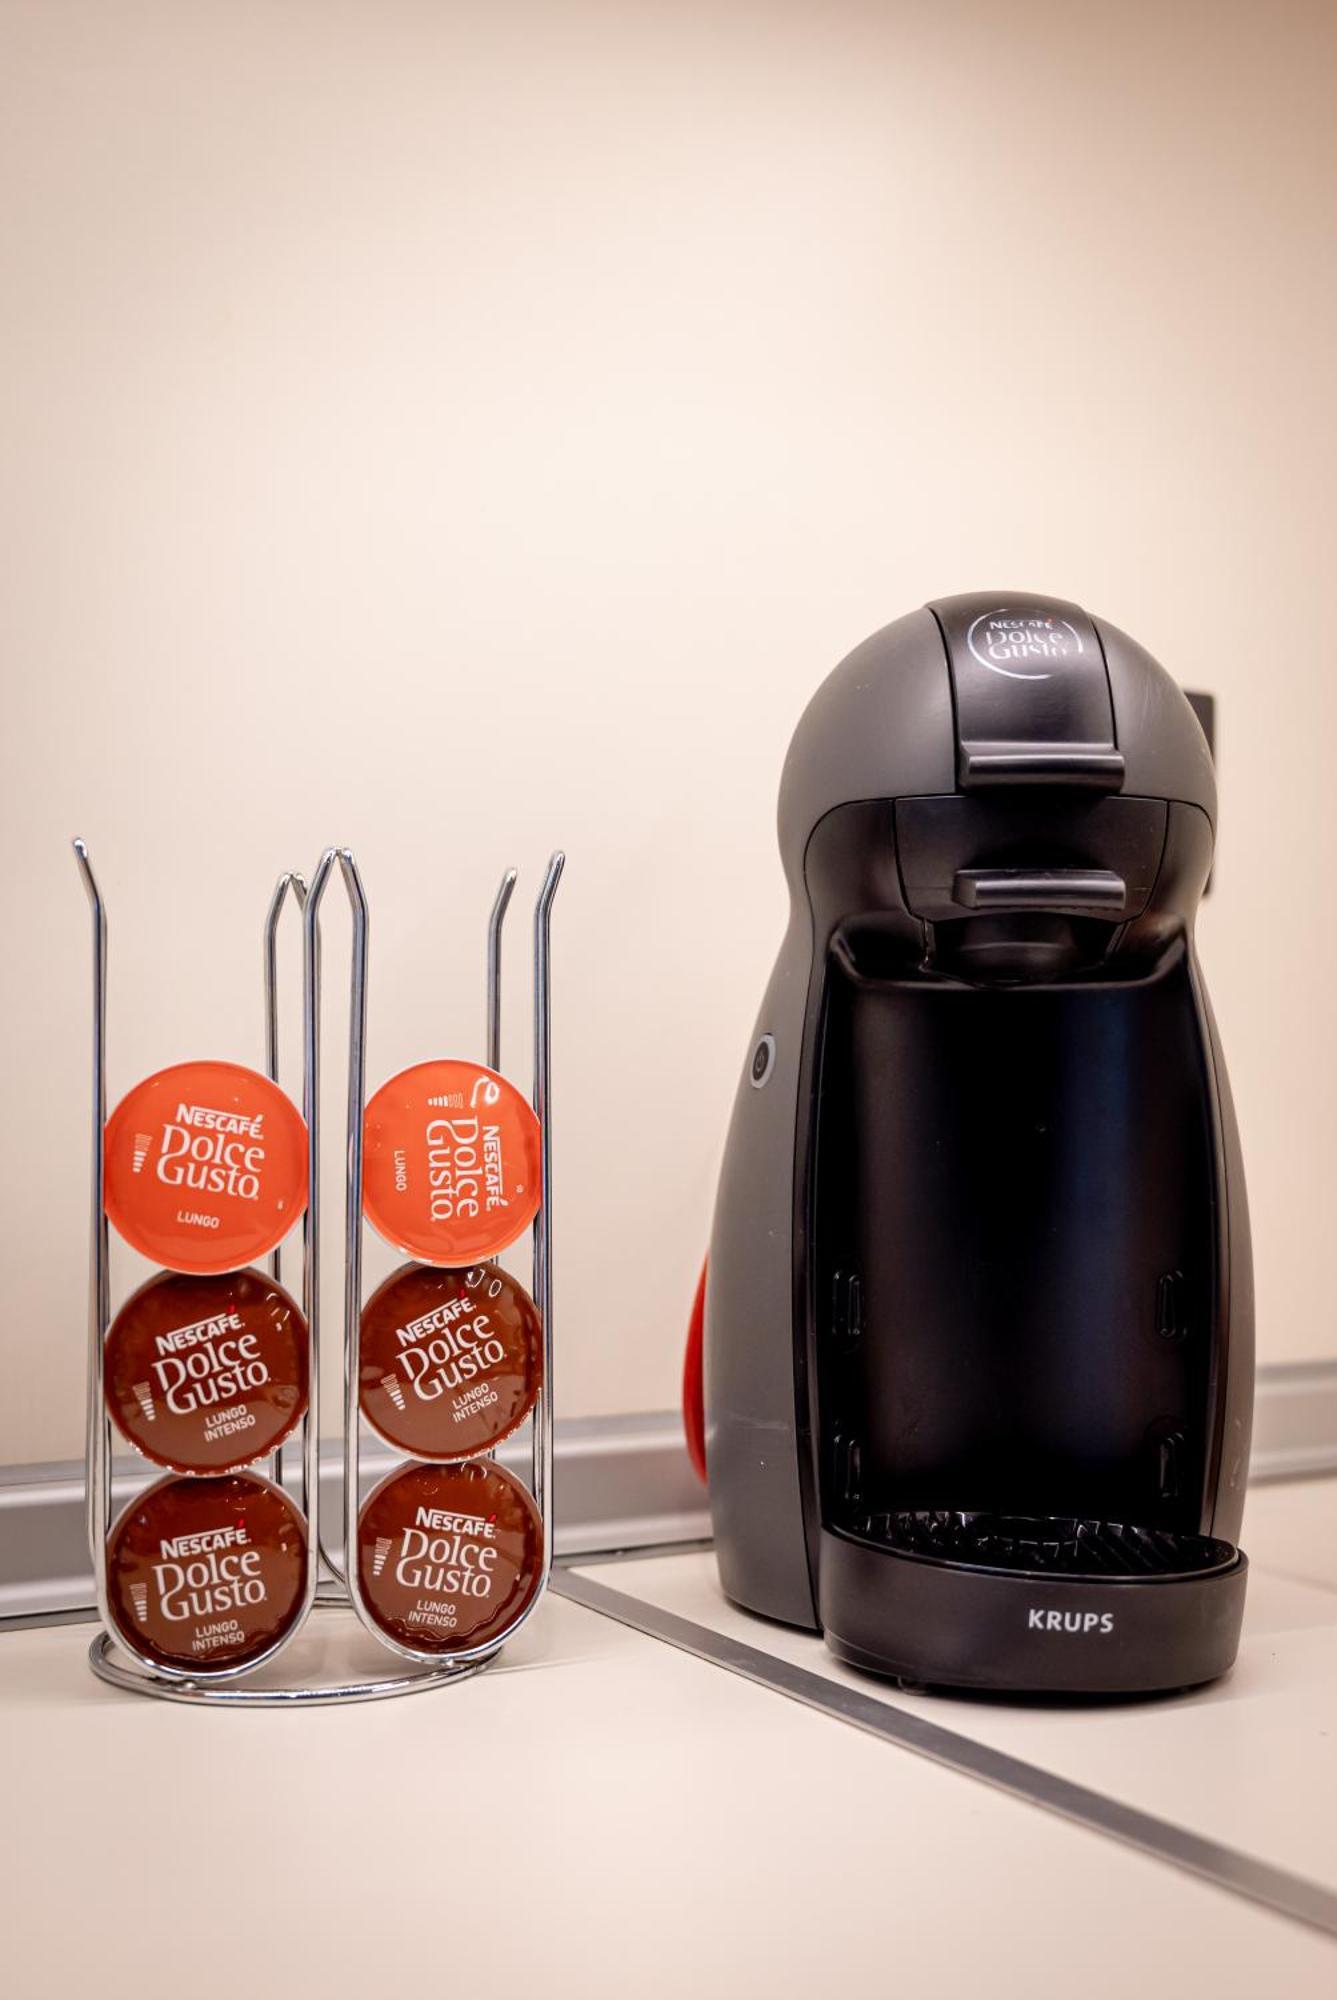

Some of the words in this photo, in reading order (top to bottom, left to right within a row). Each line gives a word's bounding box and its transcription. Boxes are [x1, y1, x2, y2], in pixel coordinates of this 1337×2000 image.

[161, 1124, 265, 1173] Dolce
[452, 1116, 483, 1217] Dolce
[156, 1153, 260, 1200] Gusto
[394, 1150, 407, 1191] LUNGO
[426, 1119, 453, 1221] Gusto
[177, 1210, 220, 1229] LUNGO
[152, 1334, 261, 1391] Dolce
[396, 1315, 494, 1380] Dolce
[166, 1361, 271, 1415] Gusto
[413, 1339, 507, 1401] Gusto
[205, 1404, 247, 1428] LUNGO
[452, 1383, 489, 1410] LUNGO
[452, 1391, 498, 1423] INTENSO
[204, 1415, 256, 1442] INTENSO
[401, 1528, 498, 1572] Dolce
[152, 1551, 261, 1596] Dolce
[396, 1556, 491, 1598] Gusto
[160, 1579, 268, 1621] Gusto
[408, 1611, 457, 1628] INTENSO
[416, 1599, 456, 1615] LUNGO
[1028, 1609, 1114, 1633] KRUPS
[192, 1631, 245, 1651] INTENSO
[195, 1619, 238, 1637] LUNGO
